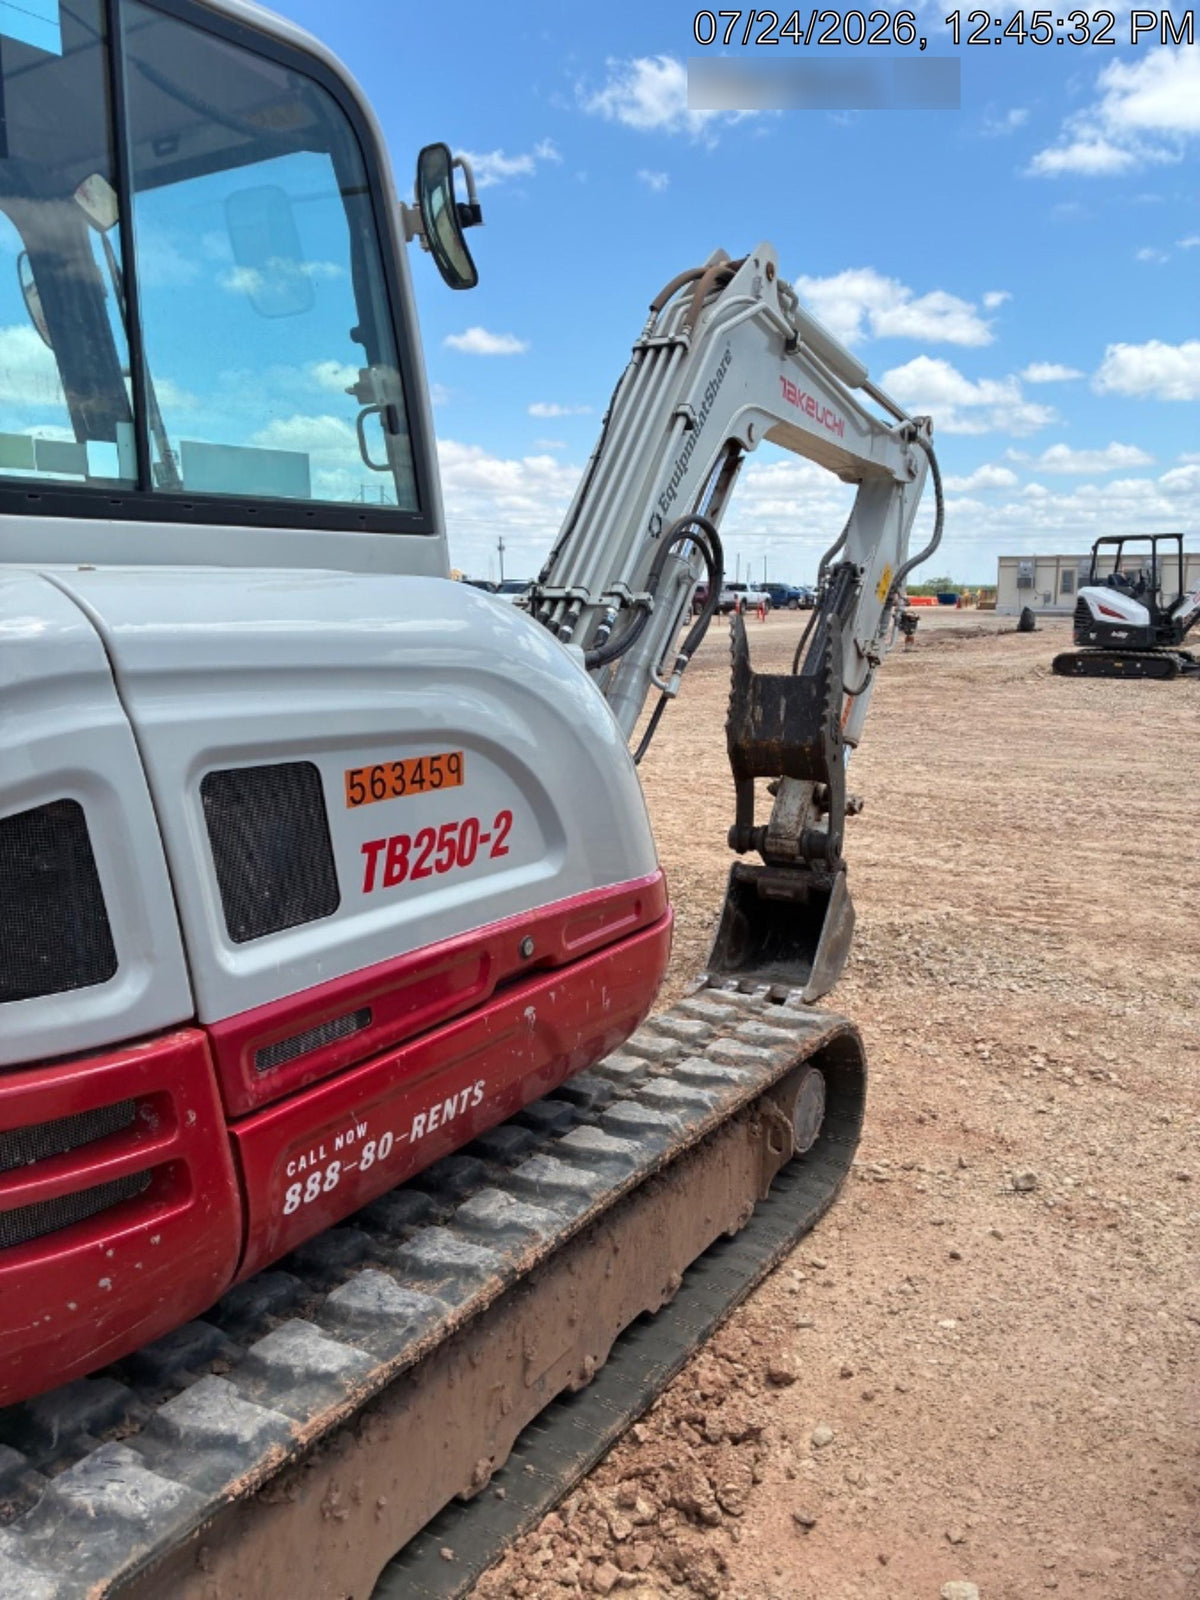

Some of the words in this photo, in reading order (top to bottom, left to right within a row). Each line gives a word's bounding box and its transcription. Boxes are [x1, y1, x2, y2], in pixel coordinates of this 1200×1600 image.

[657, 348, 732, 515] EquipmentShare
[779, 375, 845, 438] TAKEUCHI
[349, 753, 462, 805] 563459
[361, 809, 513, 893] TB250-2
[283, 1079, 486, 1215] 888-80-RENTS
[286, 1145, 327, 1177] CALL
[335, 1121, 368, 1151] NOW
